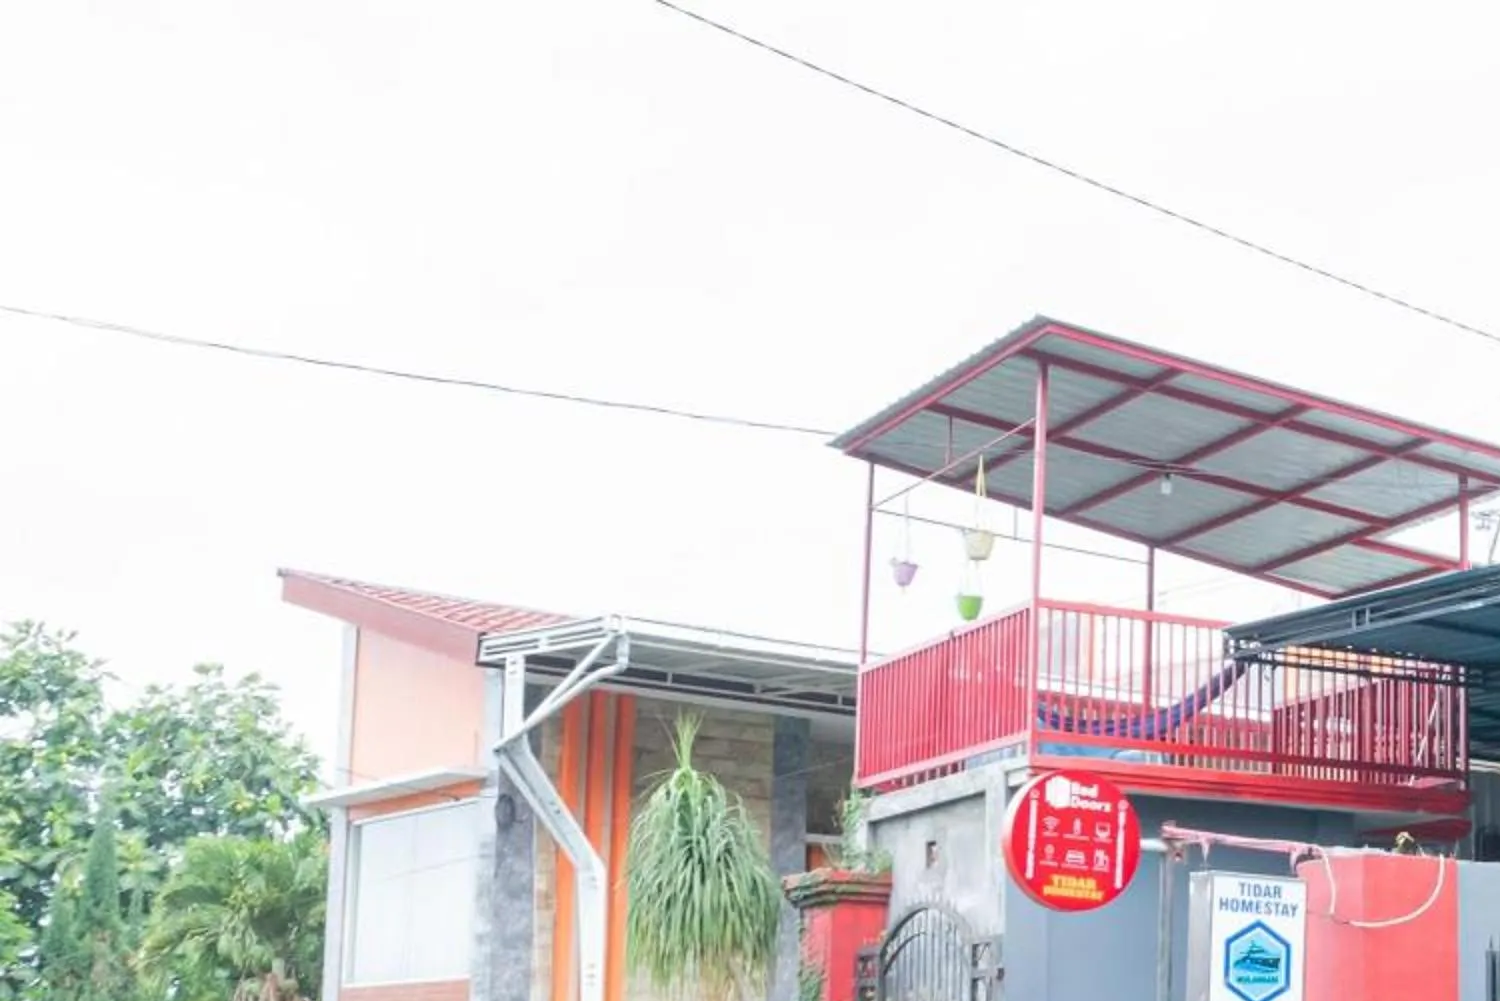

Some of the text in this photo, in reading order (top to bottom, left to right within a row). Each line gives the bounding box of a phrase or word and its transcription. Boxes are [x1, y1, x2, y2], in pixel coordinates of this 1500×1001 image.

[1071, 781, 1099, 798] Red
[1050, 874, 1097, 889] TIDAR
[1238, 882, 1283, 900] TIDAR
[1219, 898, 1299, 918] HOMESTAY
